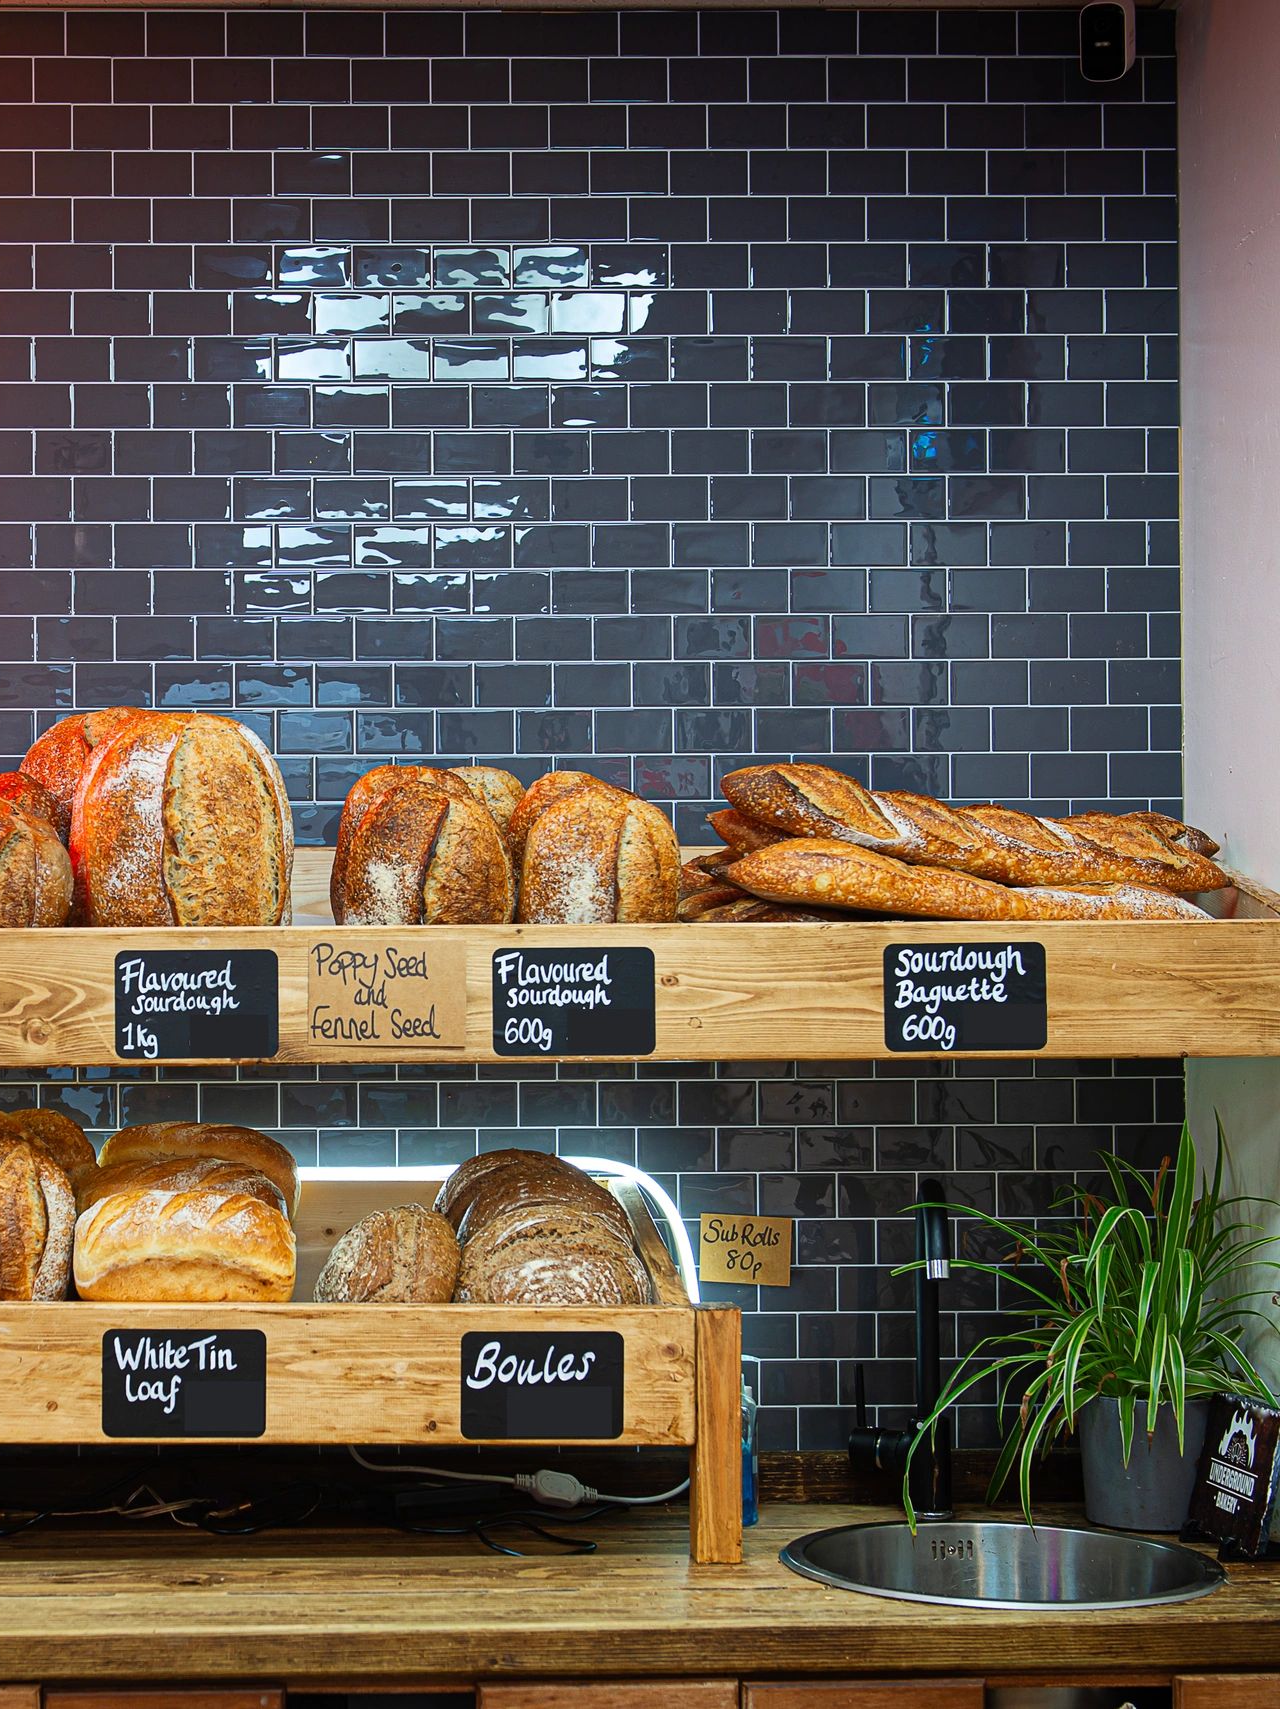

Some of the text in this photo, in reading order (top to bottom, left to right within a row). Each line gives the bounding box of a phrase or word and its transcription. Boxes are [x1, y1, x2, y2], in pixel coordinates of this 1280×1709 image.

[119, 958, 237, 994] Flavoured
[311, 943, 429, 989] Poppy Seed
[495, 952, 612, 986] Flavoured
[894, 945, 1026, 982] Sourdough
[354, 980, 388, 1009] and
[894, 978, 1008, 1014] Baguette
[391, 1004, 441, 1040] Seed
[504, 1017, 553, 1051] 600g
[902, 1014, 956, 1050] 600g
[726, 1249, 762, 1280] 80p
[114, 1335, 237, 1371] White Tin
[466, 1341, 596, 1389] Boules
[1209, 1462, 1255, 1497] UNDERGROUND
[1217, 1491, 1238, 1514] BAKERY
